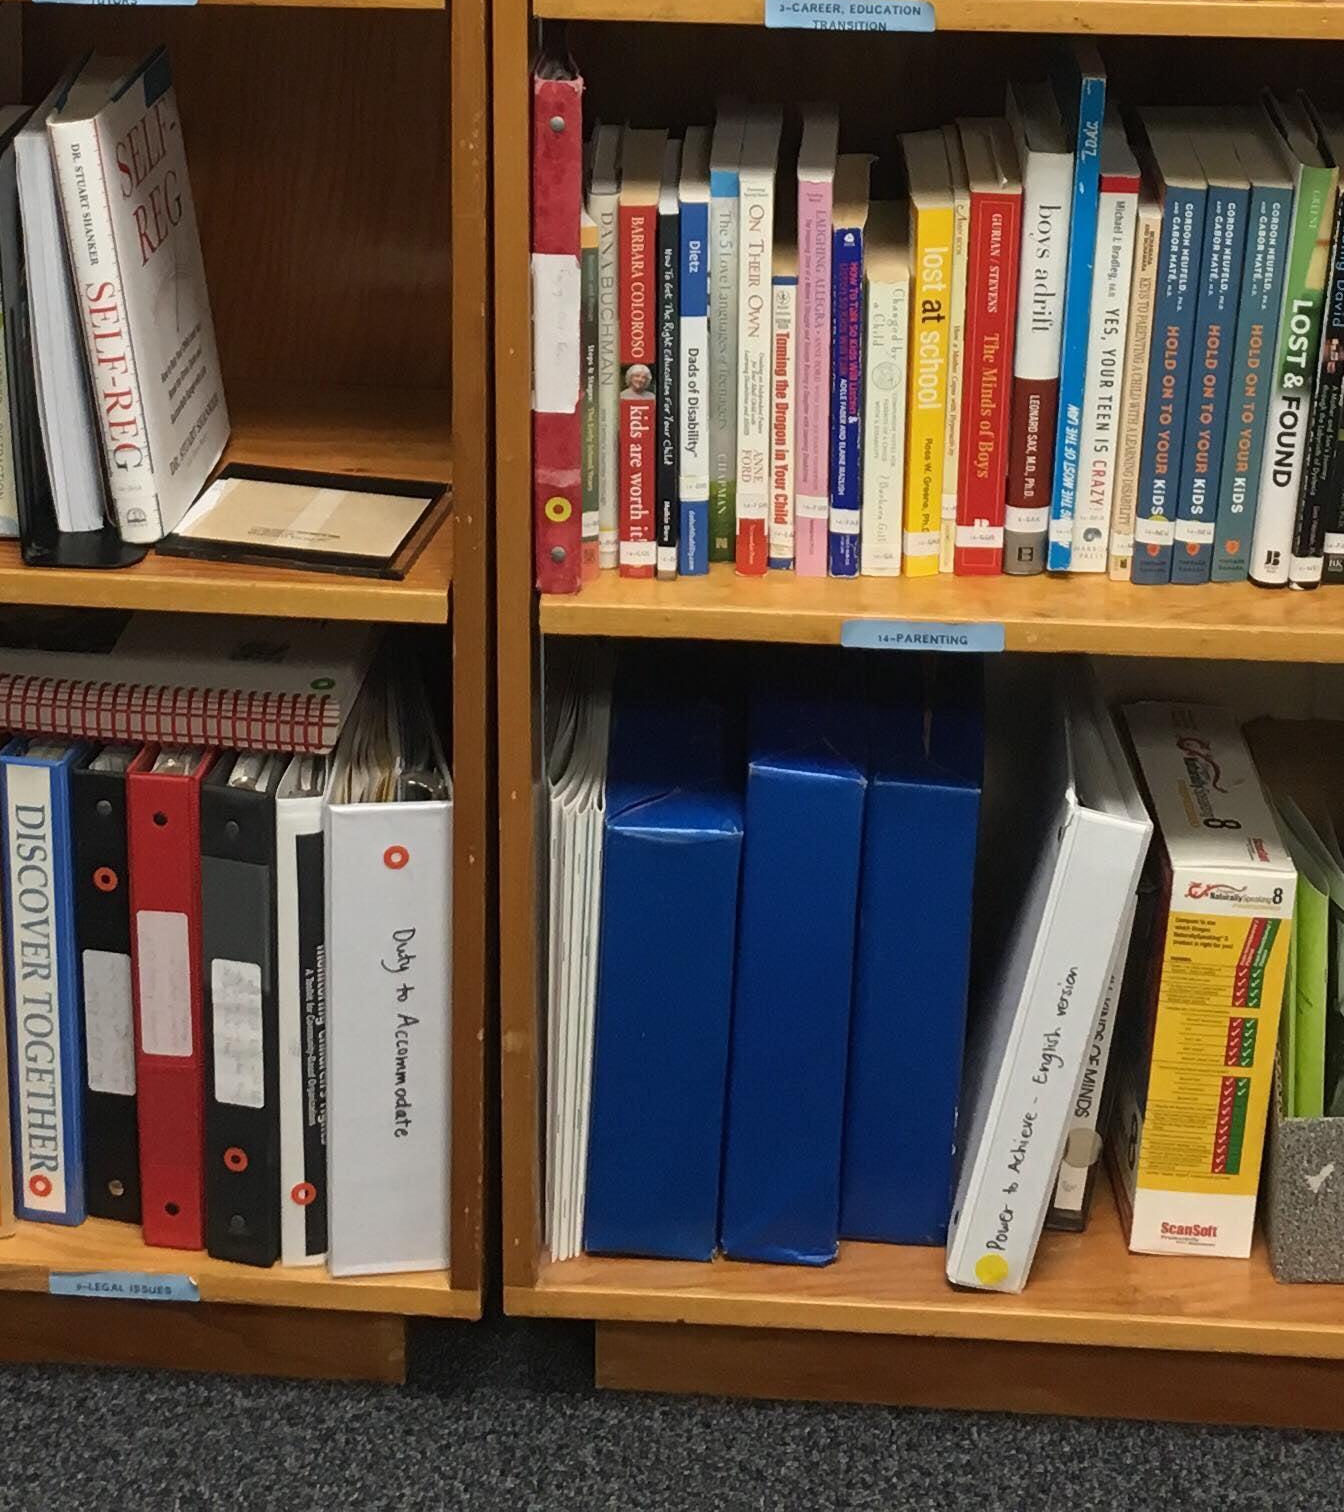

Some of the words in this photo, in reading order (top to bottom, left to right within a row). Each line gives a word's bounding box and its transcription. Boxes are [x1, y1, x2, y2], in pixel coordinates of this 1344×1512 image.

[812, 20, 888, 32] TRANSITION
[850, 3, 921, 16] EDUCATION
[630, 217, 646, 282] BARBARA
[1027, 205, 1062, 259] boys
[922, 247, 948, 294] lost
[630, 284, 646, 357] COLOROSO
[921, 300, 945, 322] at
[1030, 266, 1056, 333] adrift
[1287, 299, 1313, 378] LOST
[86, 282, 143, 472] SELF-REG
[918, 332, 942, 409] school
[1283, 375, 1303, 388] &
[1273, 396, 1300, 487] FOUND
[14, 804, 50, 980] DISCOVER
[381, 928, 416, 973] Duty
[397, 984, 415, 1002] to
[1056, 966, 1079, 1018] version
[393, 1013, 420, 1137] Accommodate
[1033, 1027, 1064, 1084] English
[23, 995, 58, 1172] TOGETHER
[1008, 1112, 1037, 1173] Achieve
[1002, 1177, 1019, 1196] to
[987, 1207, 1013, 1252] Power
[1161, 1223, 1217, 1237] ScanSoft
